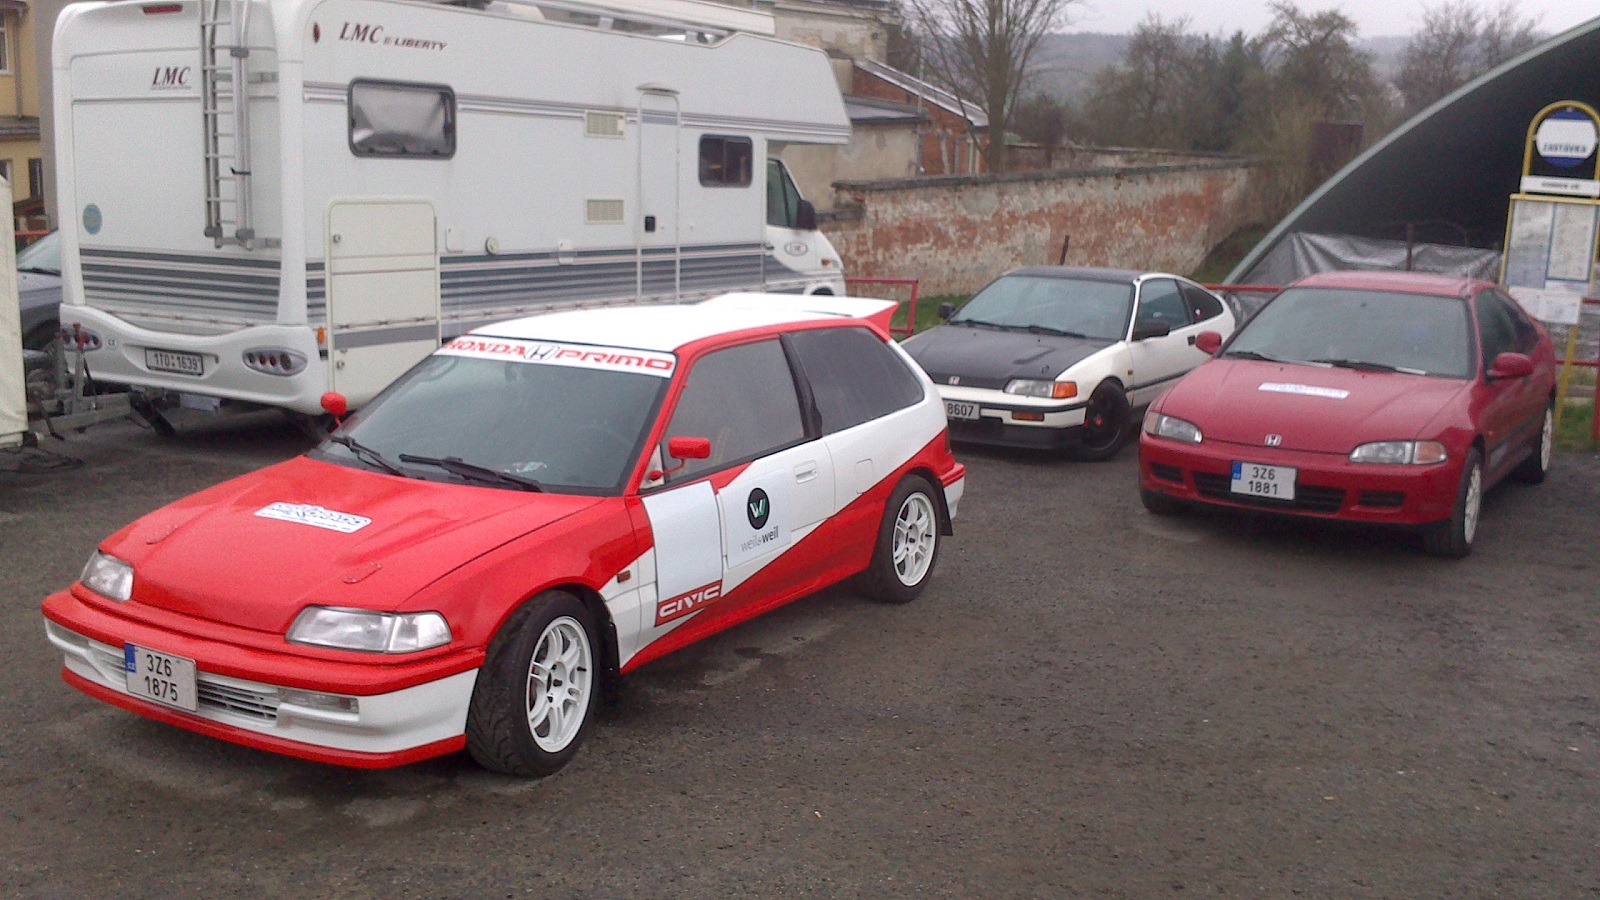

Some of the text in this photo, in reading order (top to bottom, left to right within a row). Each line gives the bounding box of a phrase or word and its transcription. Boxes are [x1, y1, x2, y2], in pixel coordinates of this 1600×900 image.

[339, 22, 447, 52] LMC LIBERTY
[152, 66, 191, 86] LMC
[176, 356, 198, 371] 1639
[443, 340, 674, 371] HONDA PRIMO
[947, 403, 974, 417] 8607
[1252, 466, 1275, 481] 3Z6
[1248, 480, 1278, 495] 1881
[659, 585, 720, 618] CIVIC
[146, 653, 172, 677] 3Z6
[144, 676, 178, 702] 1875
